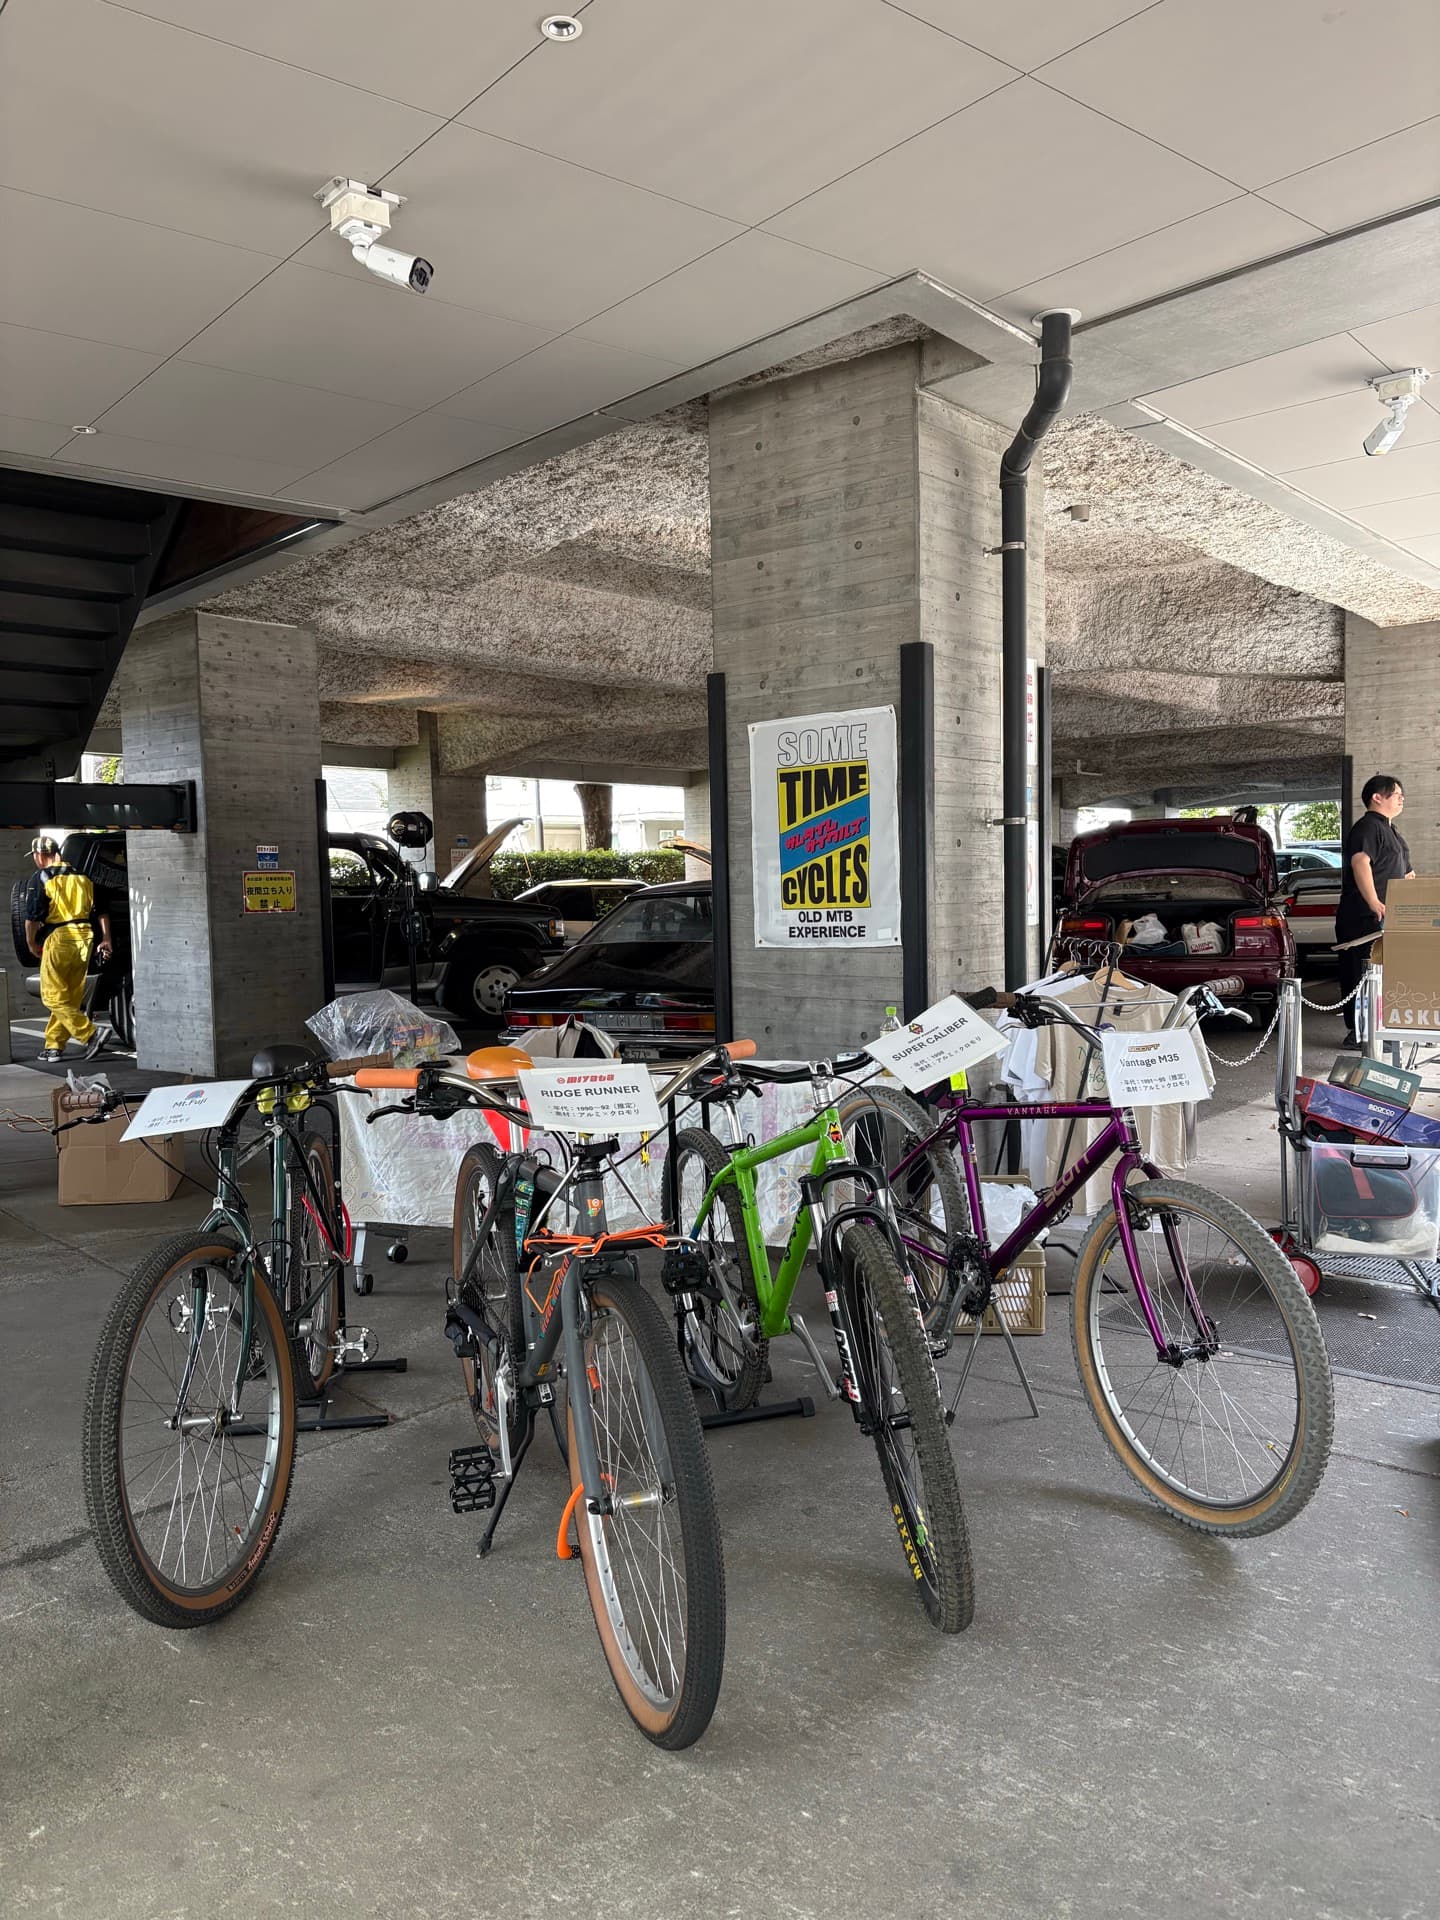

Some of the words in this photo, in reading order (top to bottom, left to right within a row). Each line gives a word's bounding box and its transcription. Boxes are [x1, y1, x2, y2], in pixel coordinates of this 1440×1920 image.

[777, 723, 868, 767] SOME
[779, 765, 868, 827] TIME
[782, 843, 868, 906] CYCLES
[246, 886, 293, 896] 夜間立ち入り
[798, 910, 823, 924] OLD
[826, 910, 853, 923] MTB
[788, 925, 866, 939] EXPERIENCE
[892, 1041, 927, 1062] SUPER
[926, 1016, 969, 1045] CALIBER
[1120, 1057, 1157, 1068] Vantage
[1159, 1053, 1180, 1064] M35
[540, 1089, 582, 1098] RIDGE
[585, 1085, 641, 1097] RUNNER
[1007, 1106, 1058, 1116] VANTAGE
[892, 1504, 923, 1580] MAXXIS
